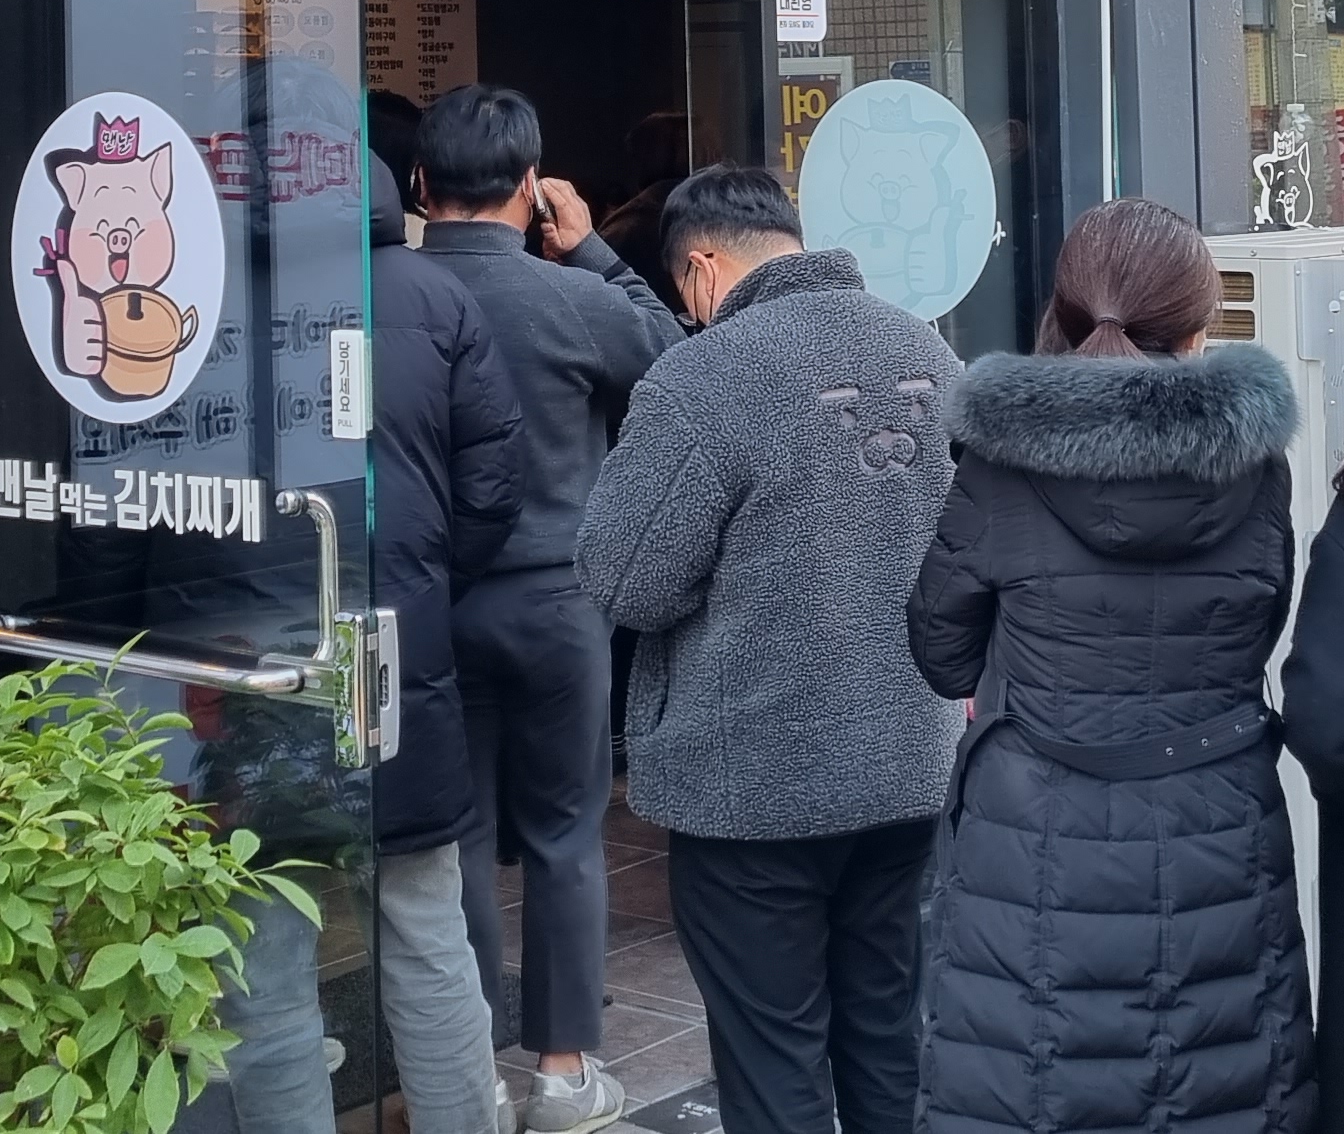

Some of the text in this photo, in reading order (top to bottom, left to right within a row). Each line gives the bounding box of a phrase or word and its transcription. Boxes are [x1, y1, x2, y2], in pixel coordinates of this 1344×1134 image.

[99, 128, 138, 157] 맨날
[338, 340, 352, 414] 당기세요
[337, 418, 354, 429] PULL
[57, 480, 109, 527] 먹는
[111, 467, 266, 545] 김치찌개
